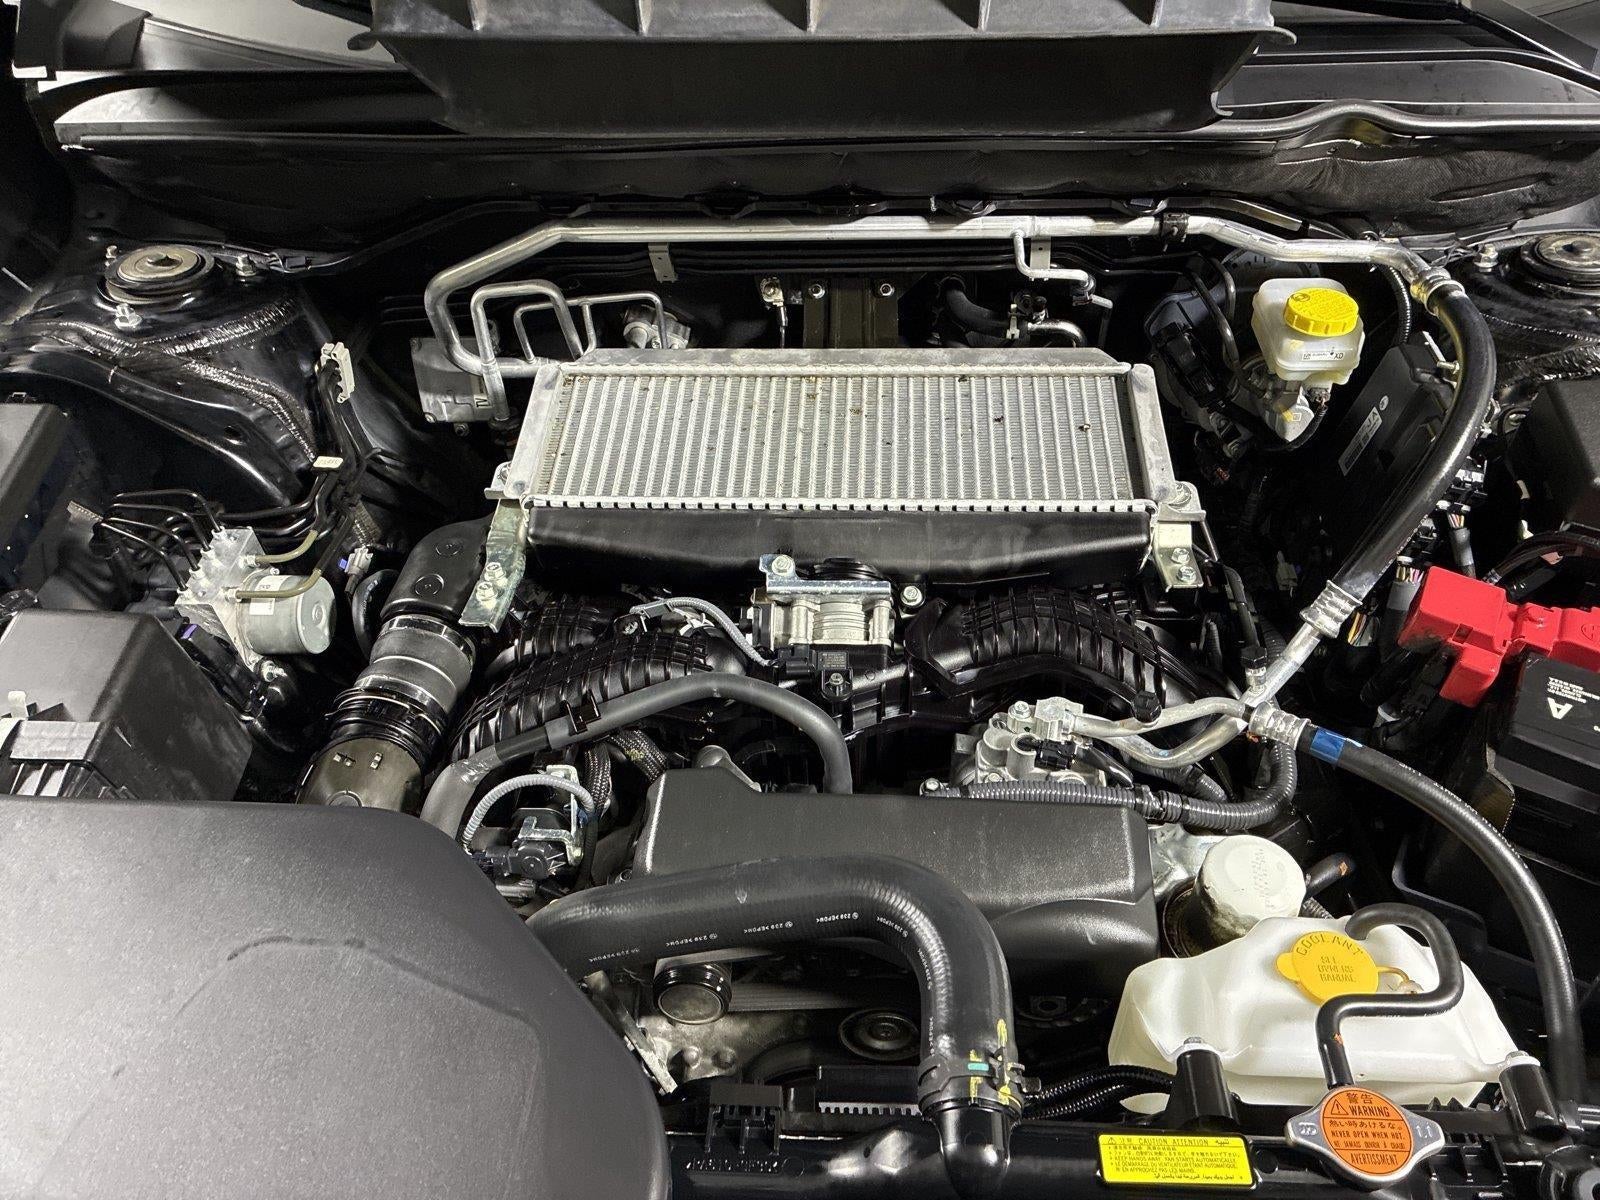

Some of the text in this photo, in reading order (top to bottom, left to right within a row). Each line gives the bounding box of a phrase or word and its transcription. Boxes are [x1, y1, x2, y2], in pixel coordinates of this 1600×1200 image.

[1547, 697, 1573, 720] A
[1295, 933, 1363, 956] COOLANT
[1346, 1092, 1373, 1104] 警告
[1348, 1105, 1390, 1117] WARNING
[1329, 1119, 1403, 1131] 熱い時あけるな。
[1331, 1130, 1351, 1138] NEVER
[1352, 1130, 1369, 1139] OPEN
[1371, 1131, 1389, 1139] WHEN
[1138, 1137, 1209, 1147] CAUTION ATTENTION
